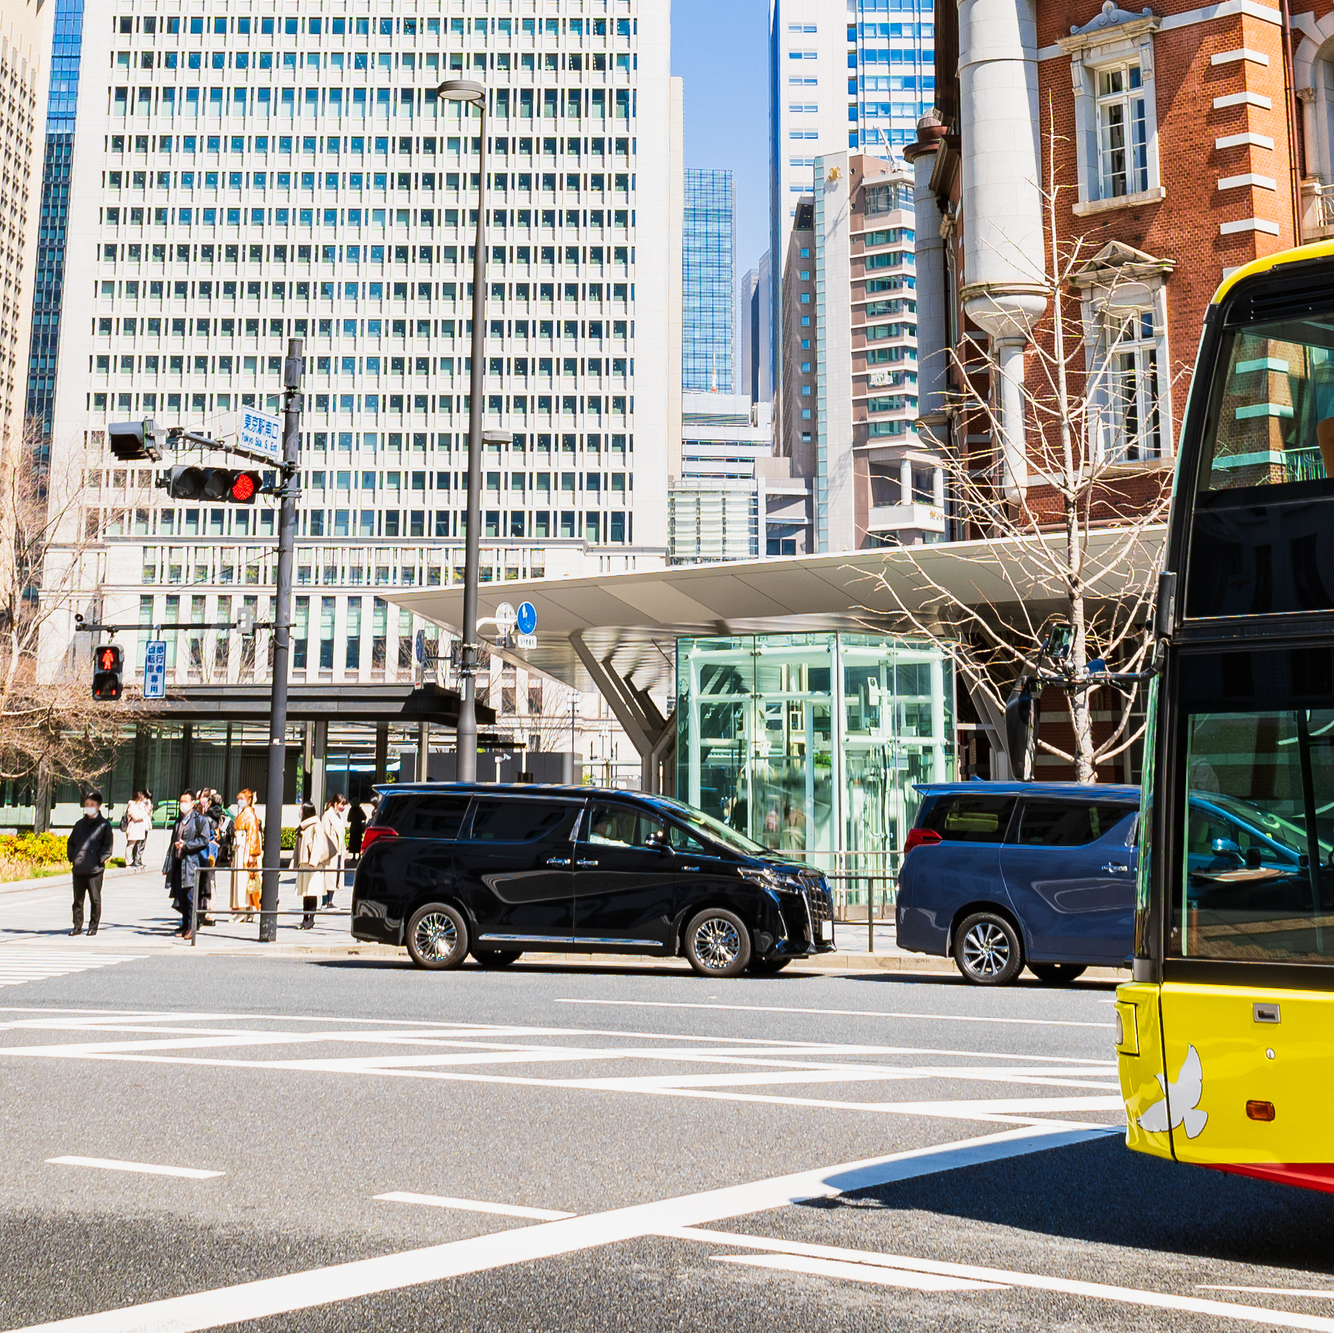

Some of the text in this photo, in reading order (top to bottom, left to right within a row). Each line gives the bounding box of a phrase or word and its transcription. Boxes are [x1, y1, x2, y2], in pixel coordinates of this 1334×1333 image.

[244, 413, 279, 439] 東京駅南口
